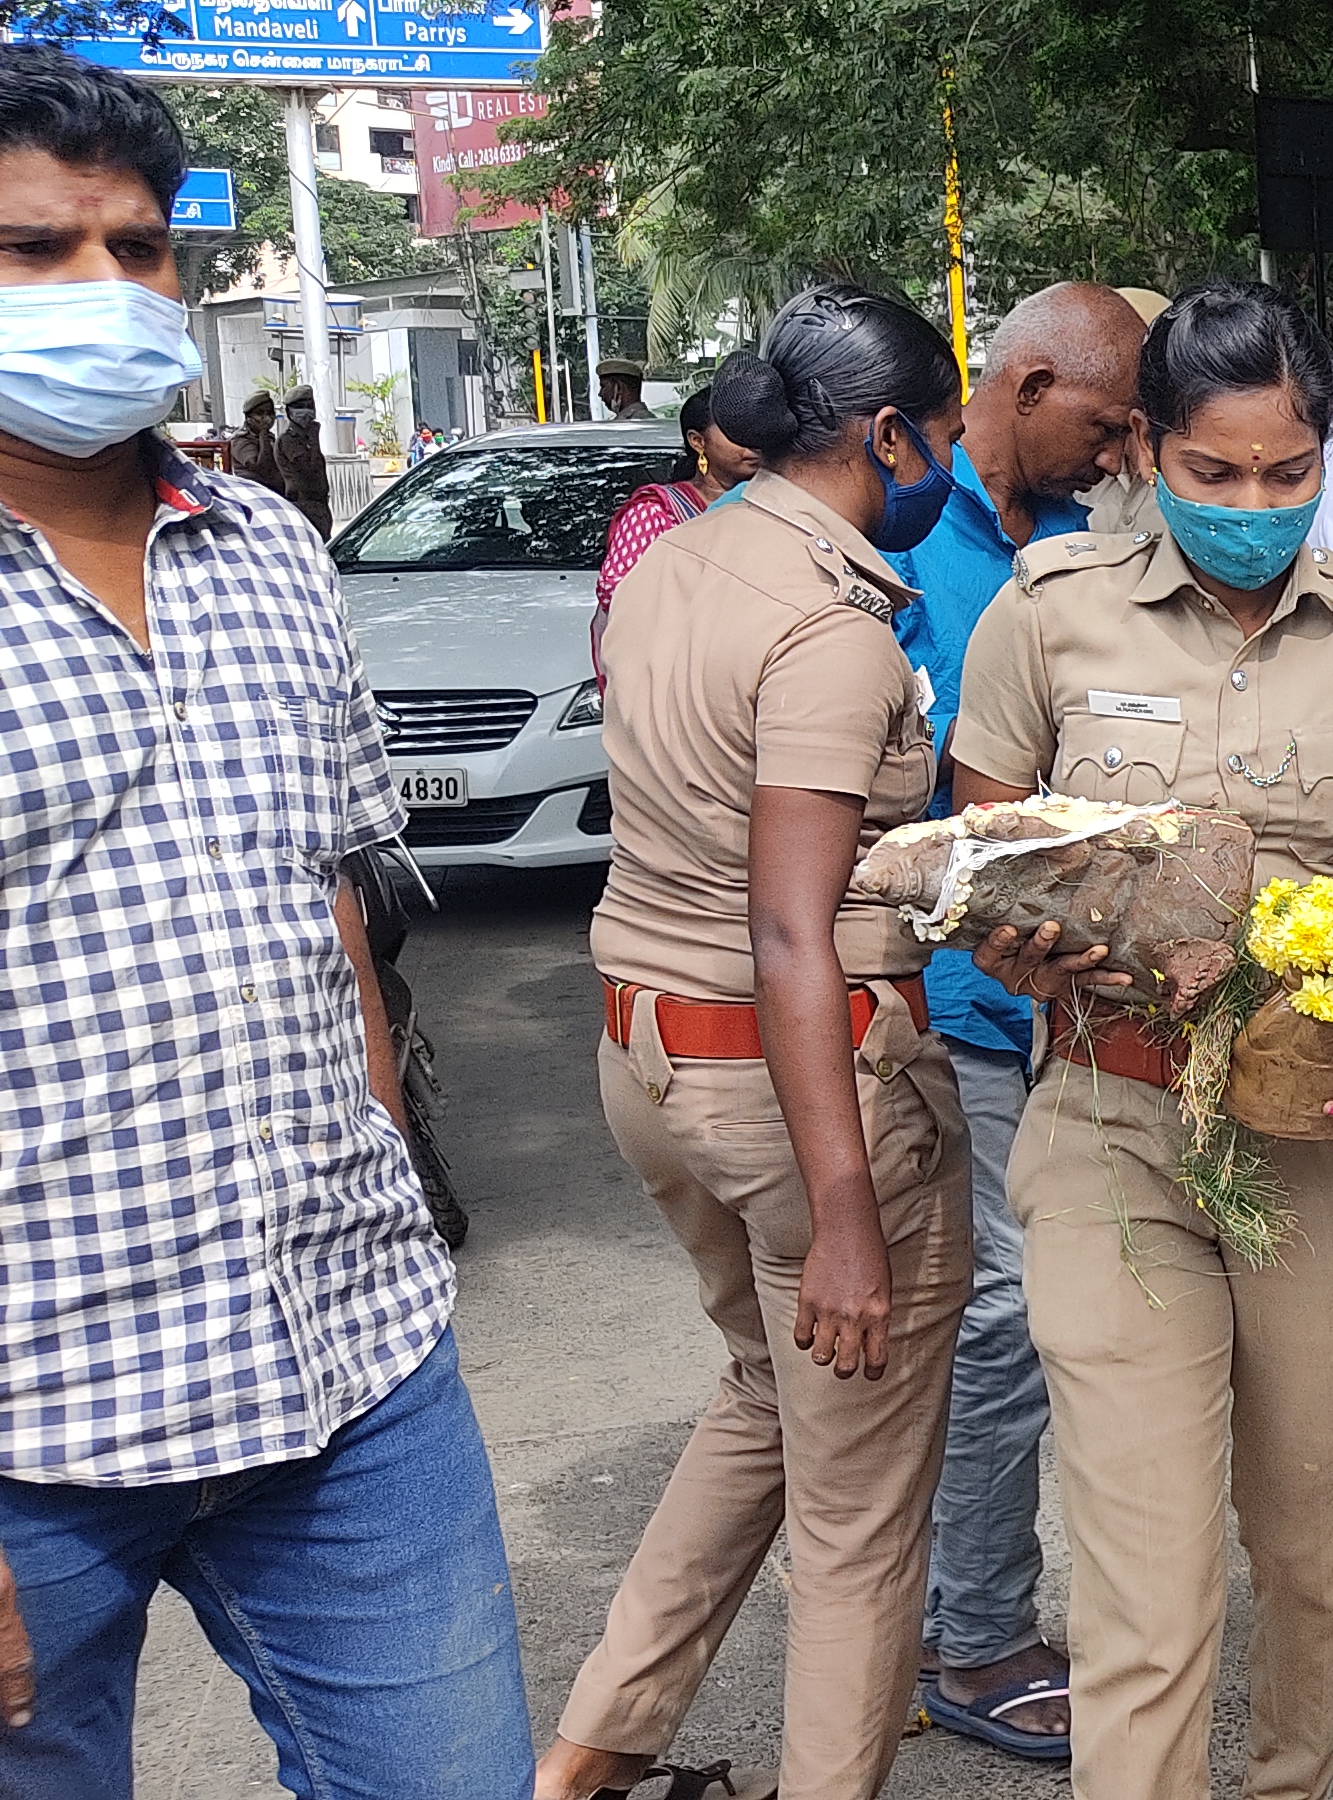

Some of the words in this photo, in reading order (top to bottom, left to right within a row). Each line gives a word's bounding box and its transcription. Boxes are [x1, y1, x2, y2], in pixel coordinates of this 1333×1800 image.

[213, 15, 319, 40] Mandaveli
[404, 20, 467, 46] Parrys
[232, 49, 324, 70] சென்னை
[327, 54, 431, 75] மாநகராட்சி
[477, 96, 512, 120] REAL
[401, 777, 458, 801] 4830
